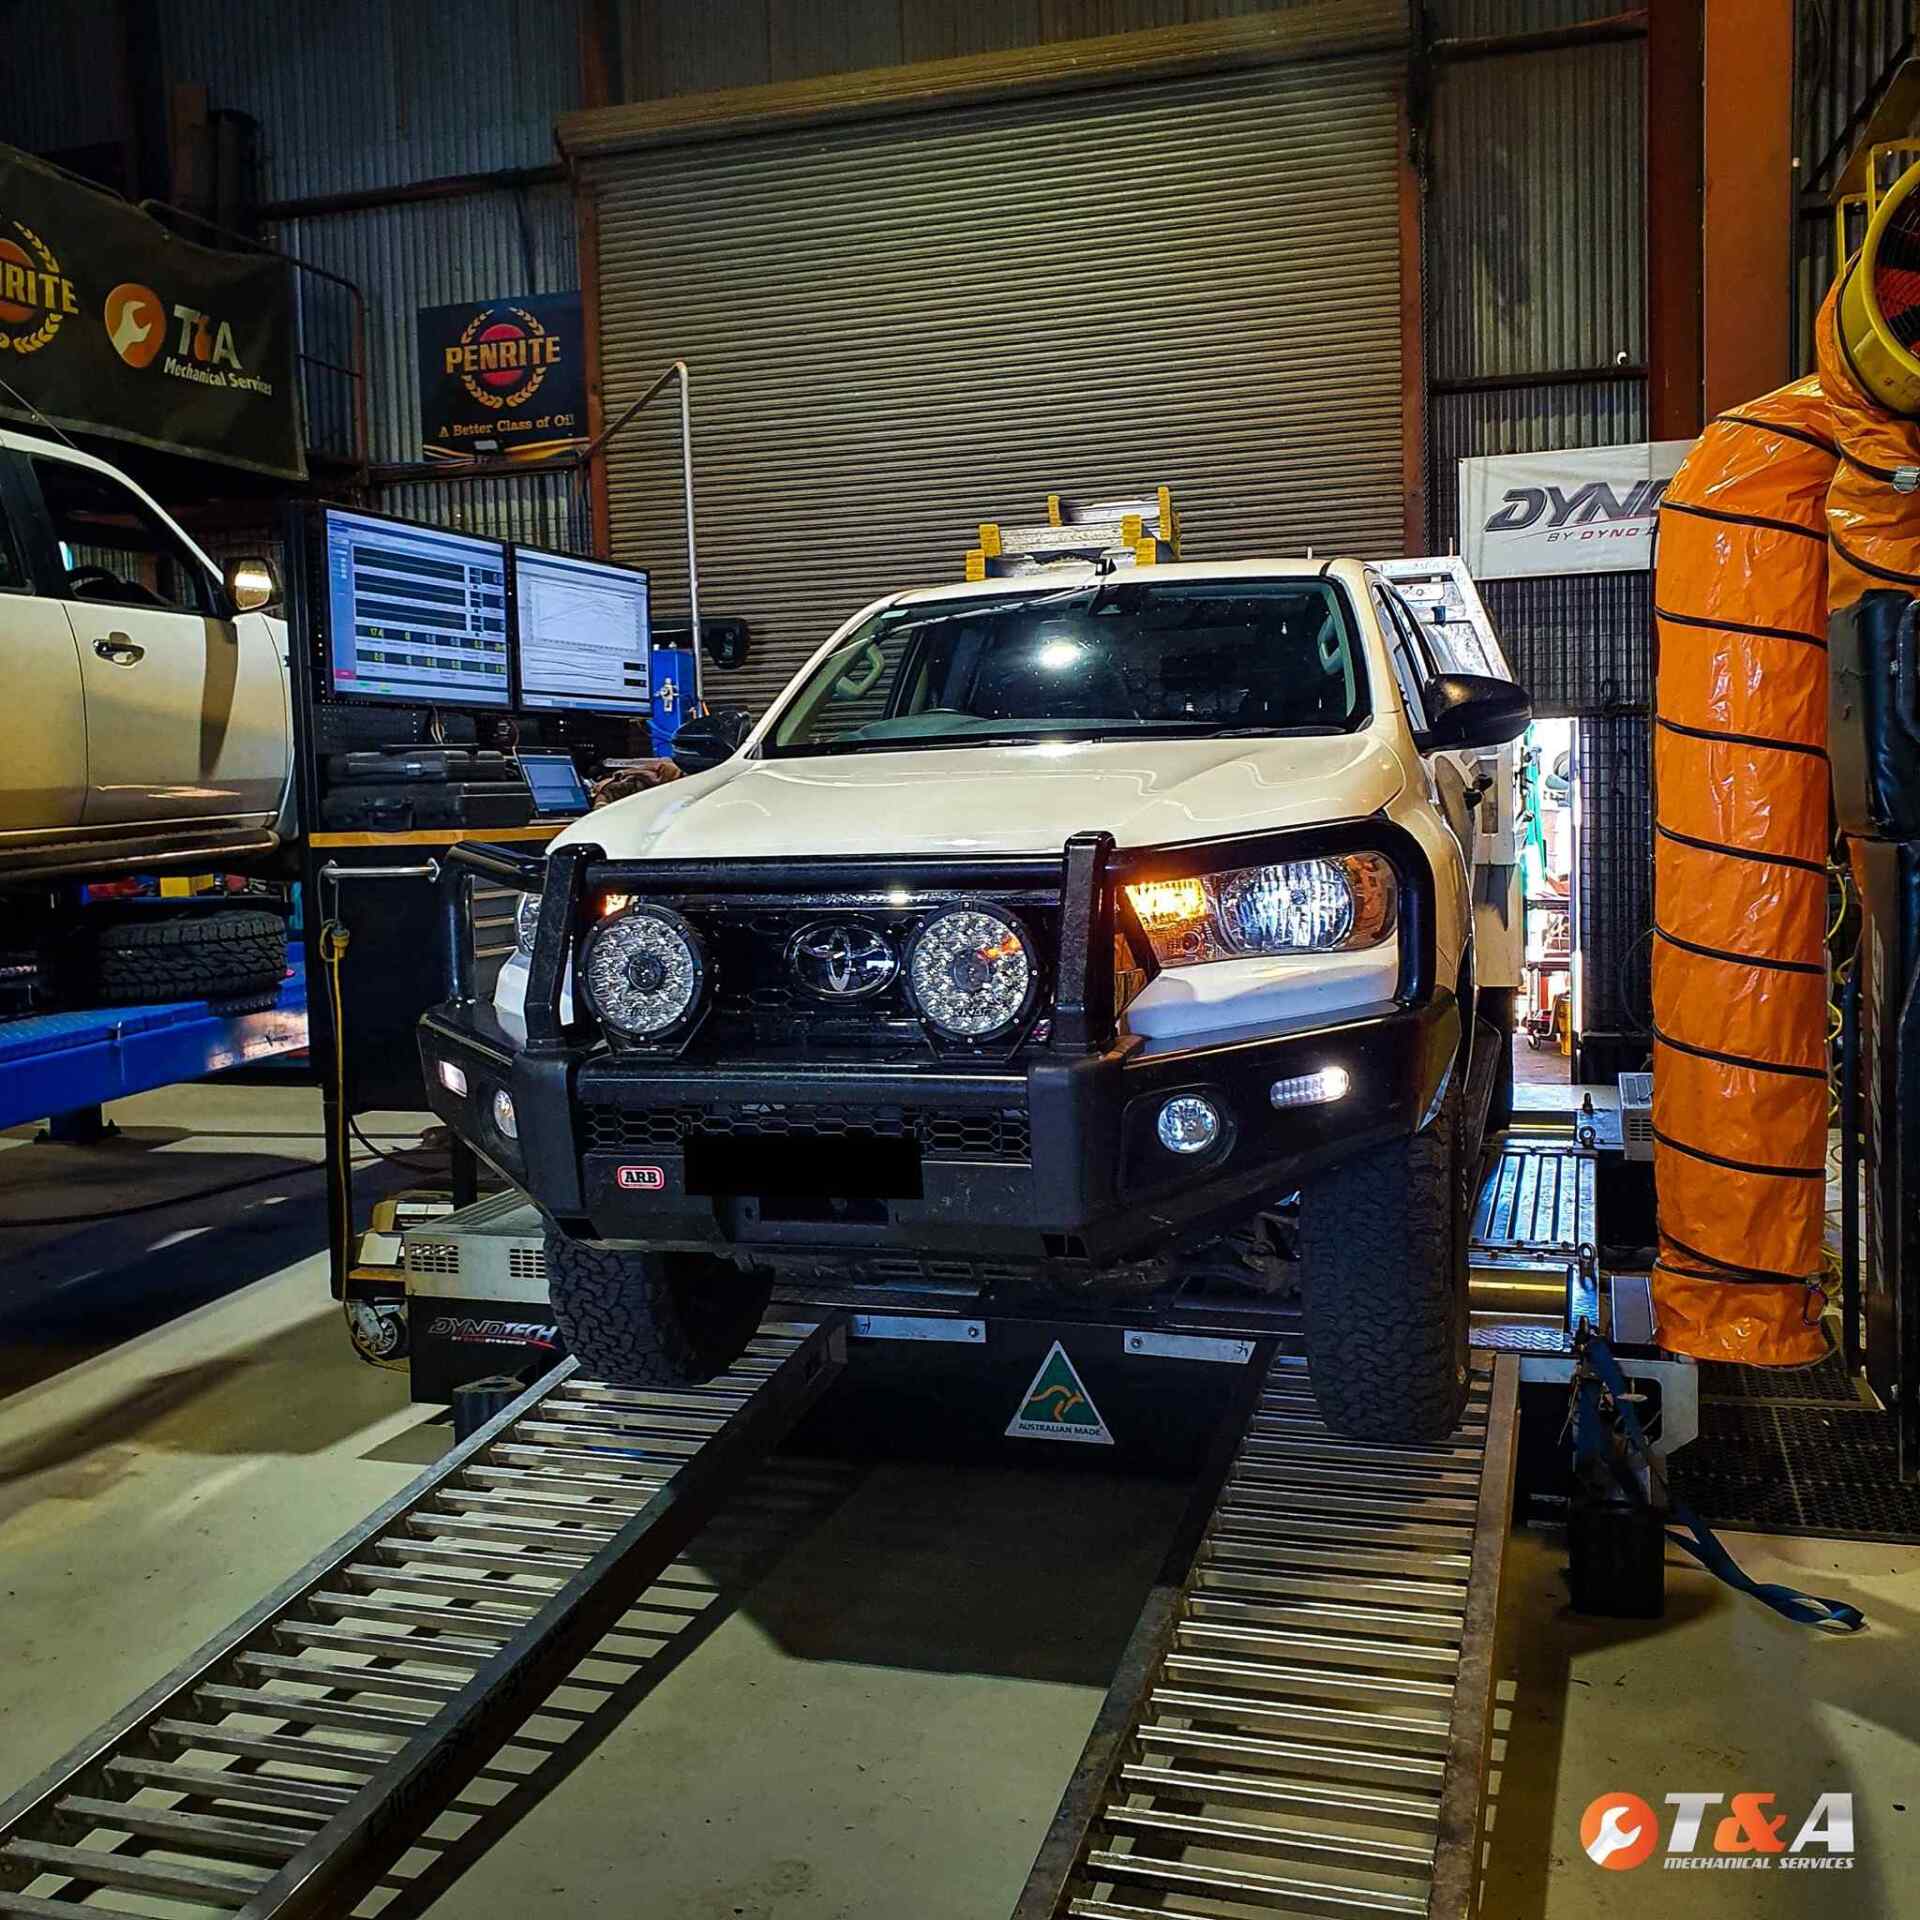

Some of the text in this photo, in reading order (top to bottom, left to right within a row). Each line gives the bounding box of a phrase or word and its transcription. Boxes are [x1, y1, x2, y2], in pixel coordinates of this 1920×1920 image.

[445, 335, 561, 374] PENRITE
[164, 356, 272, 396] Mechanical Services
[438, 413, 575, 438] A Better Class of Oil
[1547, 532, 1574, 542] BY
[1580, 527, 1640, 540] DYNO
[624, 1171, 657, 1184] ARB
[427, 1317, 559, 1341] DYNOTECH
[1018, 1423, 1101, 1436] AUSTRALIAN MADE
